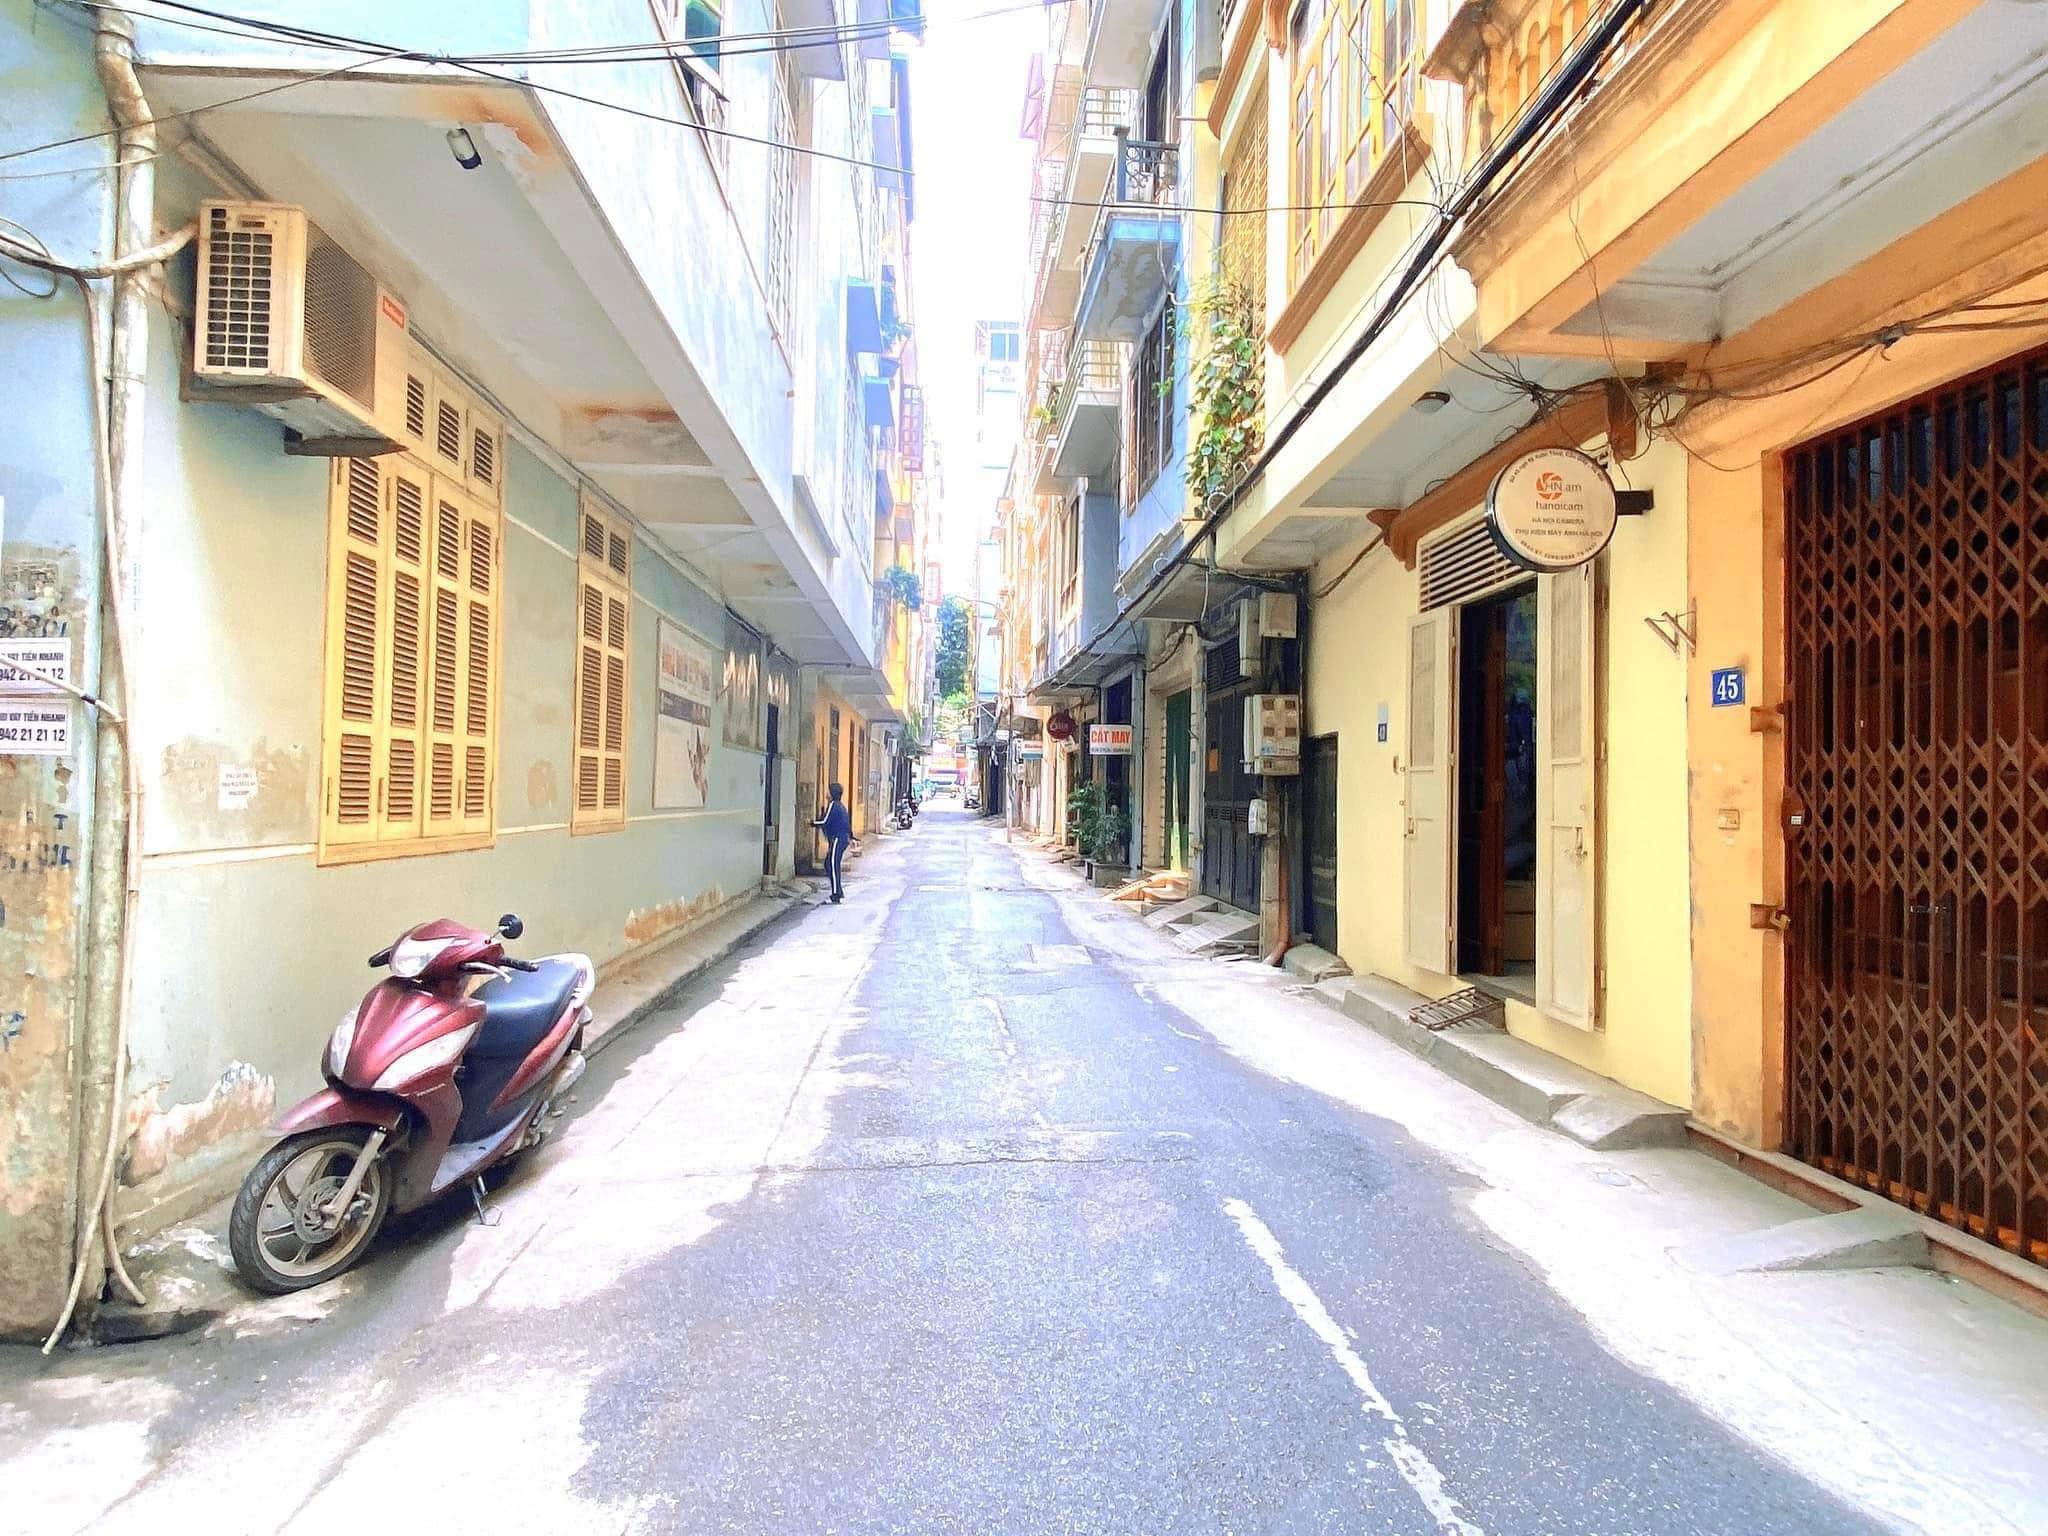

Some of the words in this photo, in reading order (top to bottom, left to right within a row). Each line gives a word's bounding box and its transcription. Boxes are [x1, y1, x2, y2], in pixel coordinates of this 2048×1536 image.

[1535, 500, 1584, 511] hanoicam
[52, 667, 64, 681] 12
[1717, 674, 1739, 701] 45
[20, 728, 32, 741] 21
[36, 728, 48, 741] 21
[53, 729, 65, 742] 12
